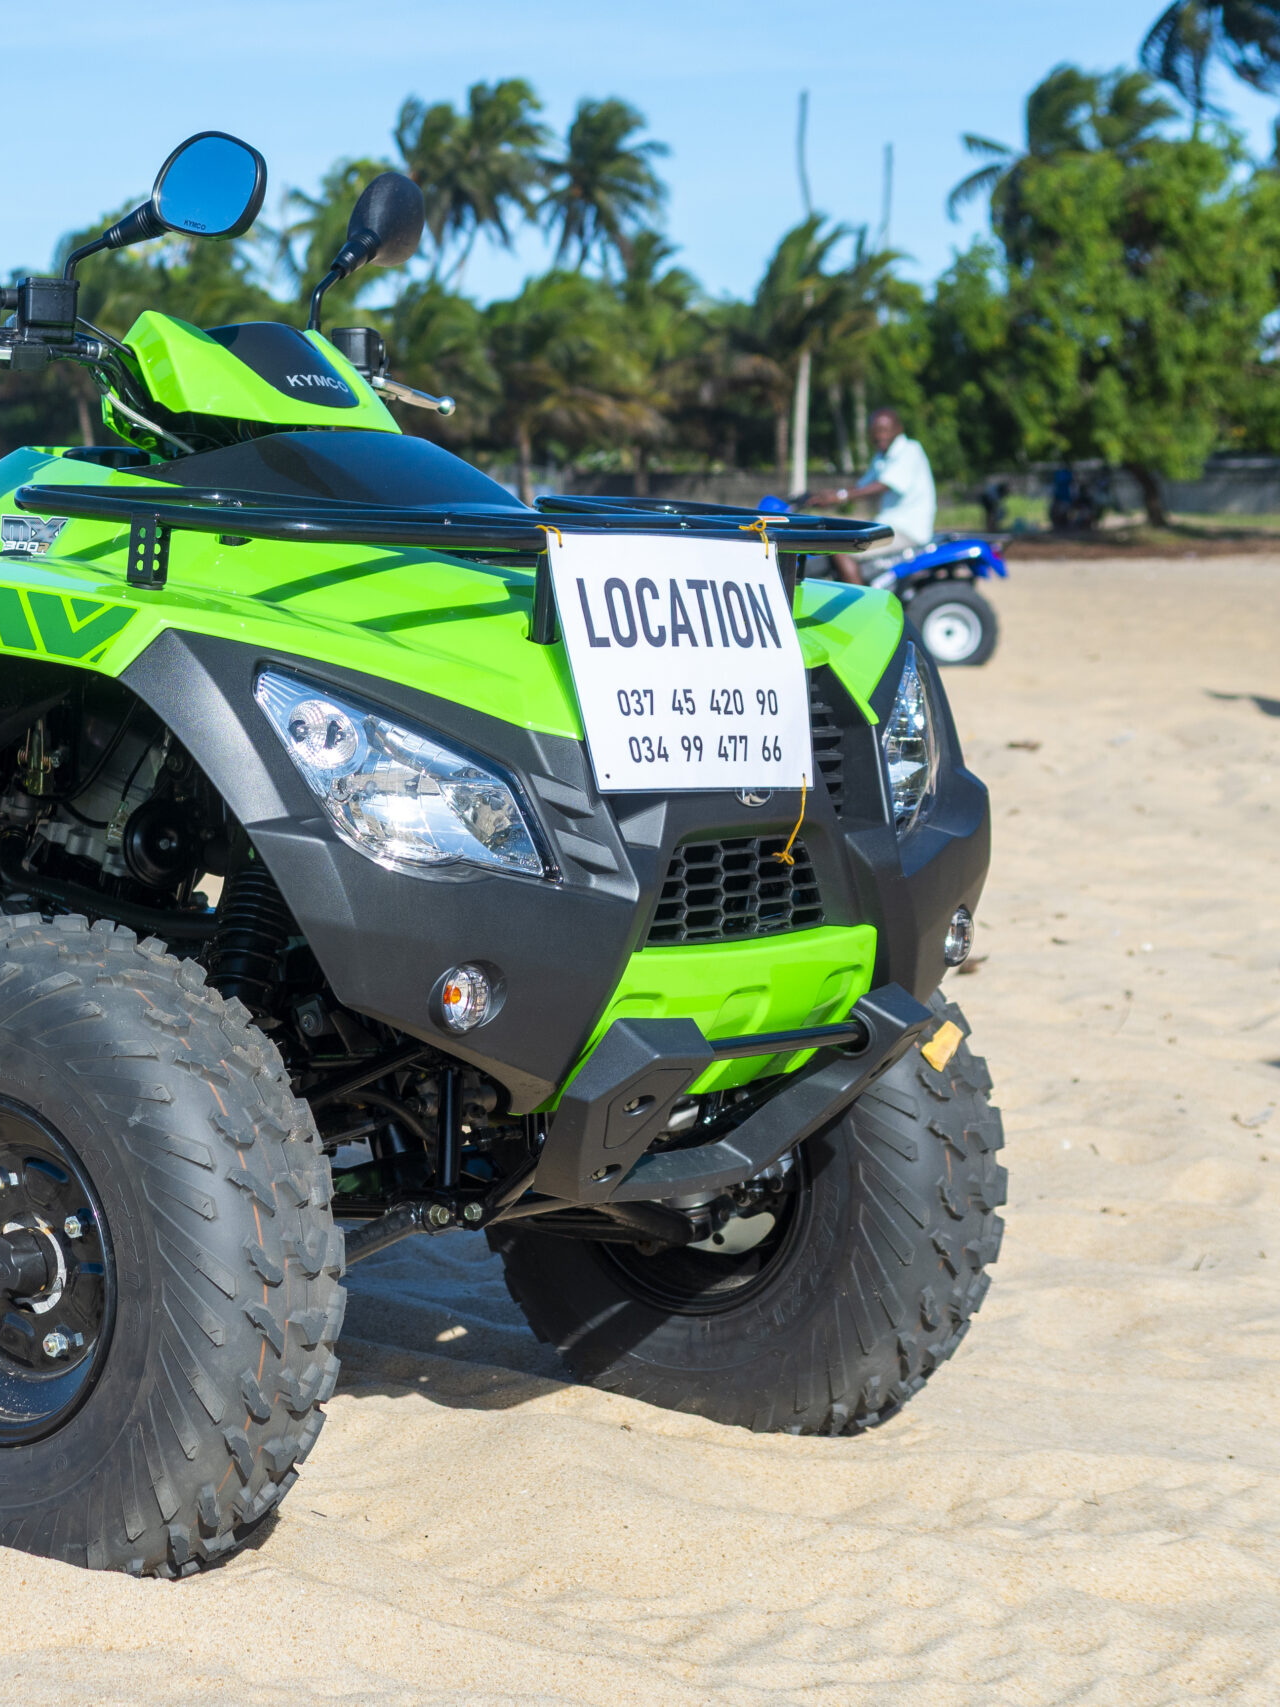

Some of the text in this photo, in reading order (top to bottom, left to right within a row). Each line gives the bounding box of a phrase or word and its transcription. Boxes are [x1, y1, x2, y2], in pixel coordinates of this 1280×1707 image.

[183, 218, 207, 231] KYMCO
[286, 374, 349, 394] KYMCO
[575, 577, 782, 649] LOCATION
[616, 688, 779, 717] 037 45 420 90
[628, 735, 782, 763] 034 99 477 66
